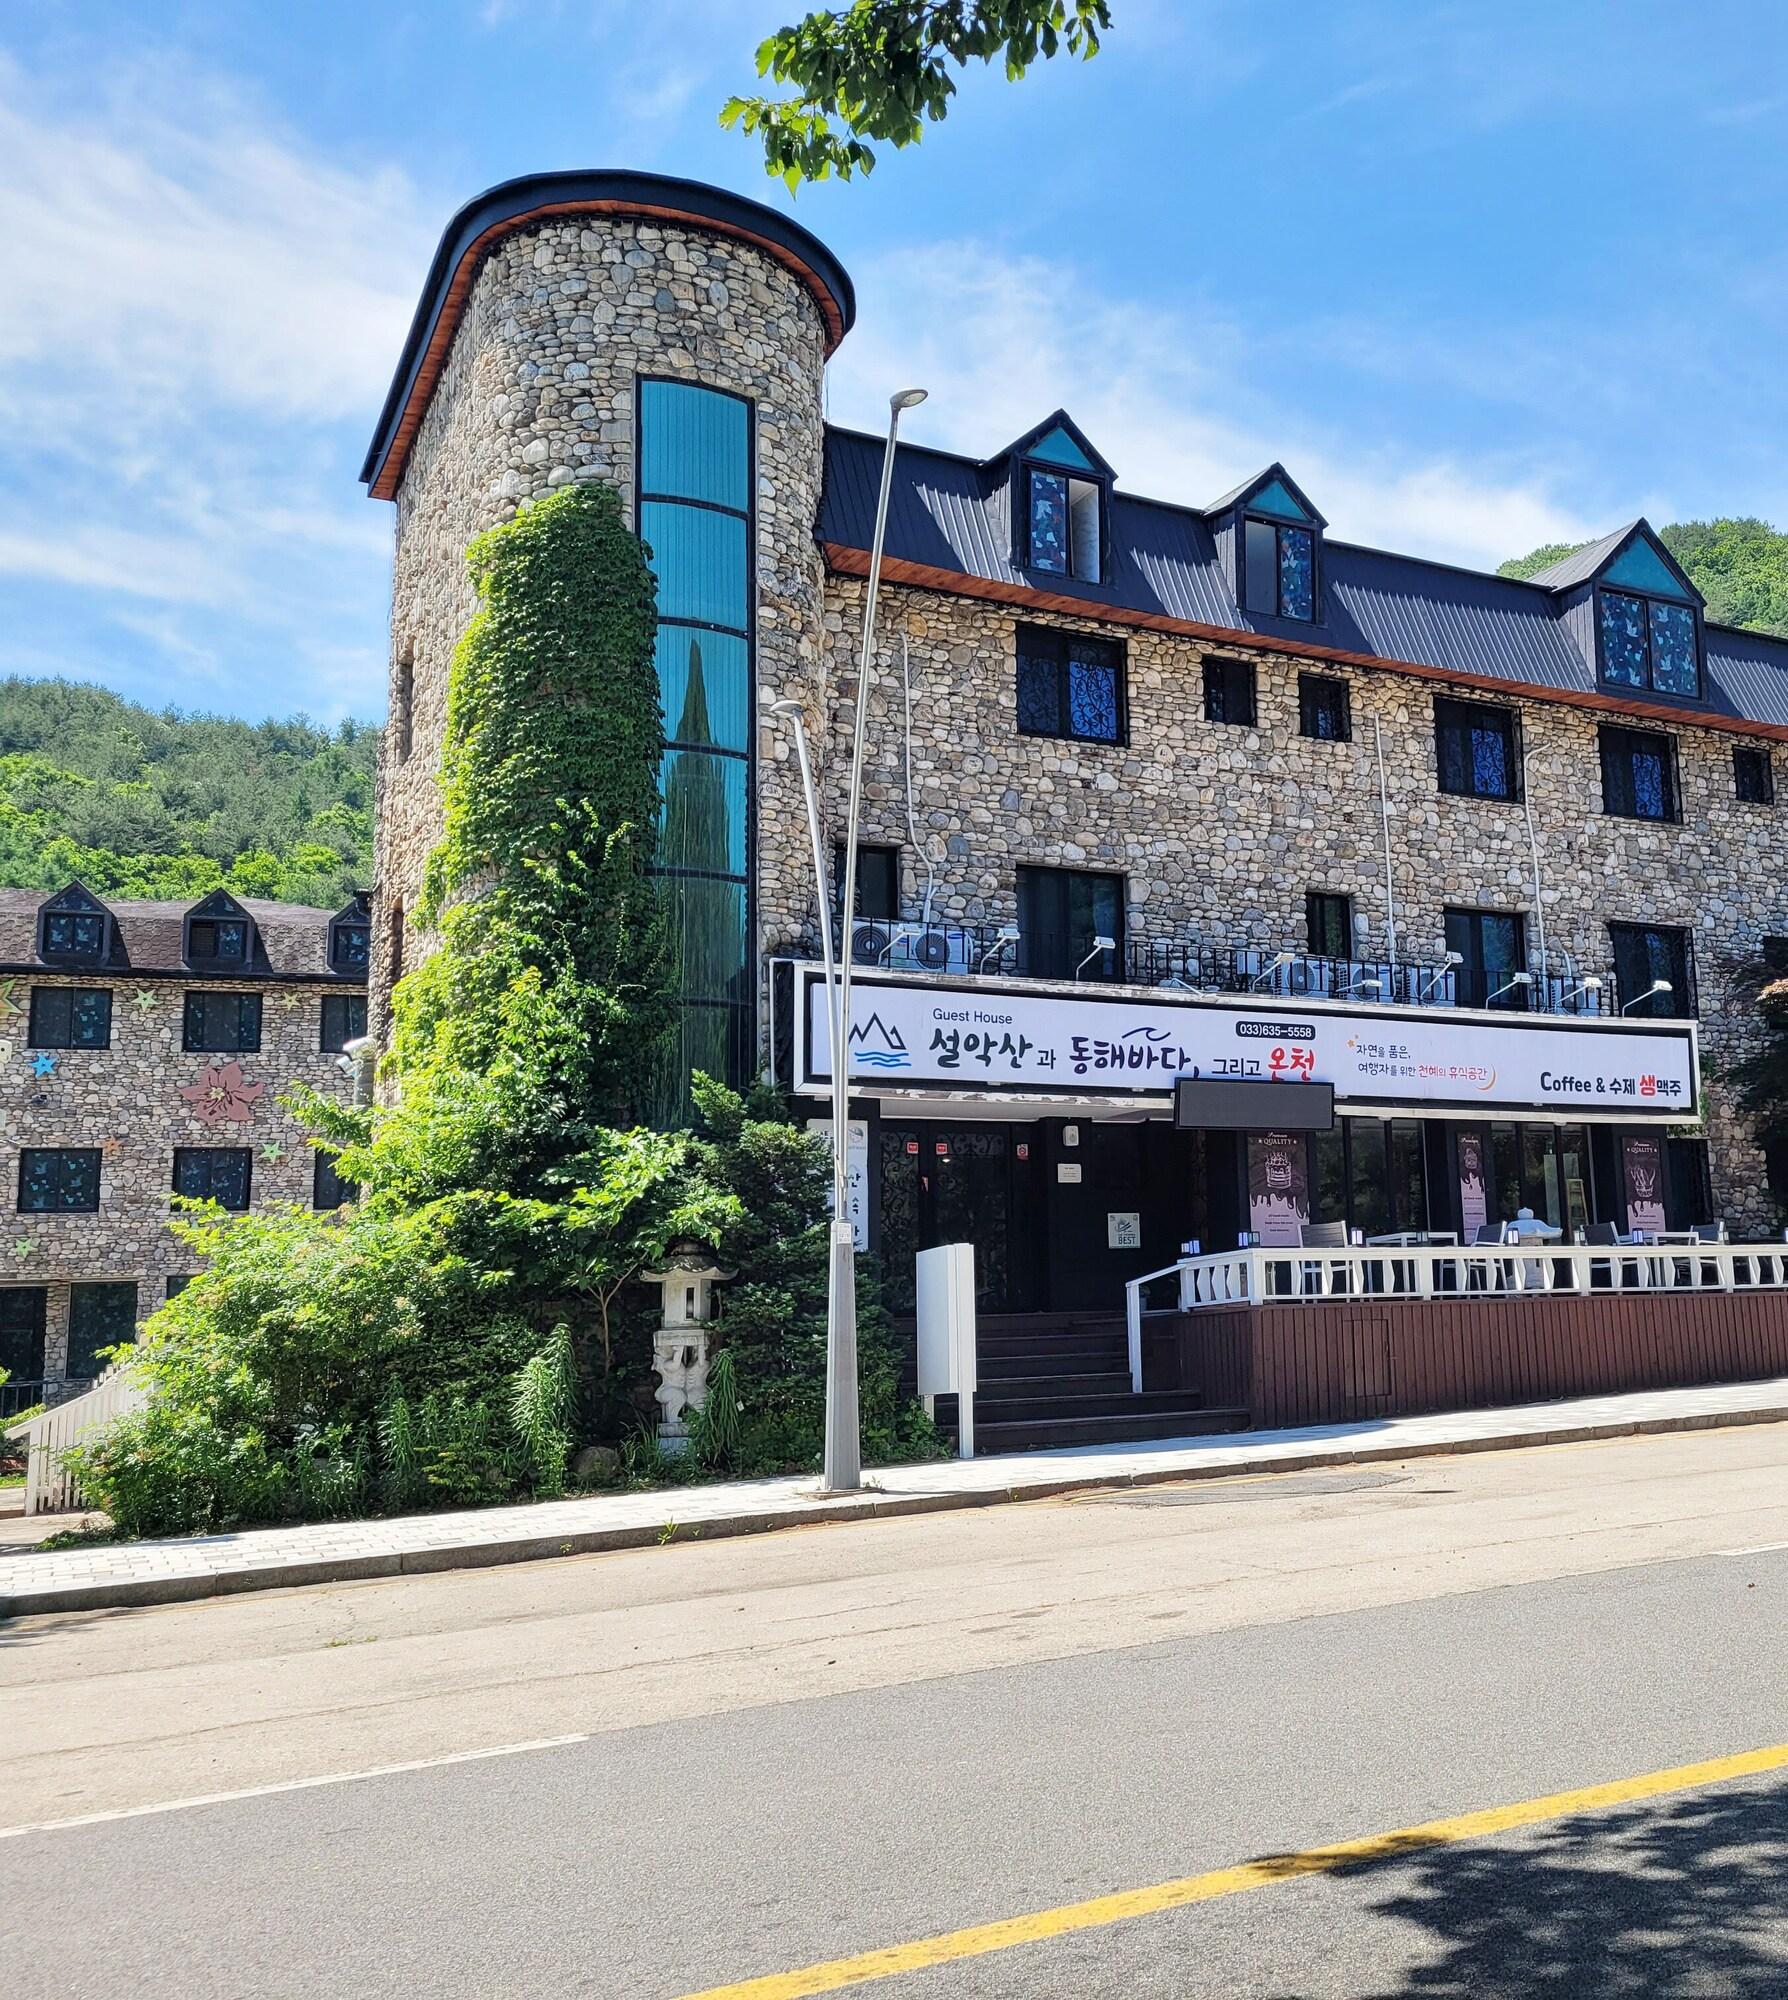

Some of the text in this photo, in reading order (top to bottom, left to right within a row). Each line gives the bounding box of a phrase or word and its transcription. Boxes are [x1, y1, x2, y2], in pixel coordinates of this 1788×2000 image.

[932, 1008, 1014, 1025] Guest House
[1240, 1023, 1313, 1038] 033)635-5558
[1356, 1044, 1386, 1058] 자연을
[1211, 1057, 1262, 1078] 그리고
[1267, 1046, 1315, 1082] 온천
[1357, 1062, 1398, 1077] 여행자를
[1399, 1065, 1417, 1078] 위한
[1449, 1066, 1488, 1081] 휴식공간
[1540, 1071, 1682, 1097] Coffee & 수제 생맥주
[1263, 1138, 1292, 1146] QUALITY
[1118, 1236, 1137, 1245] BEST
